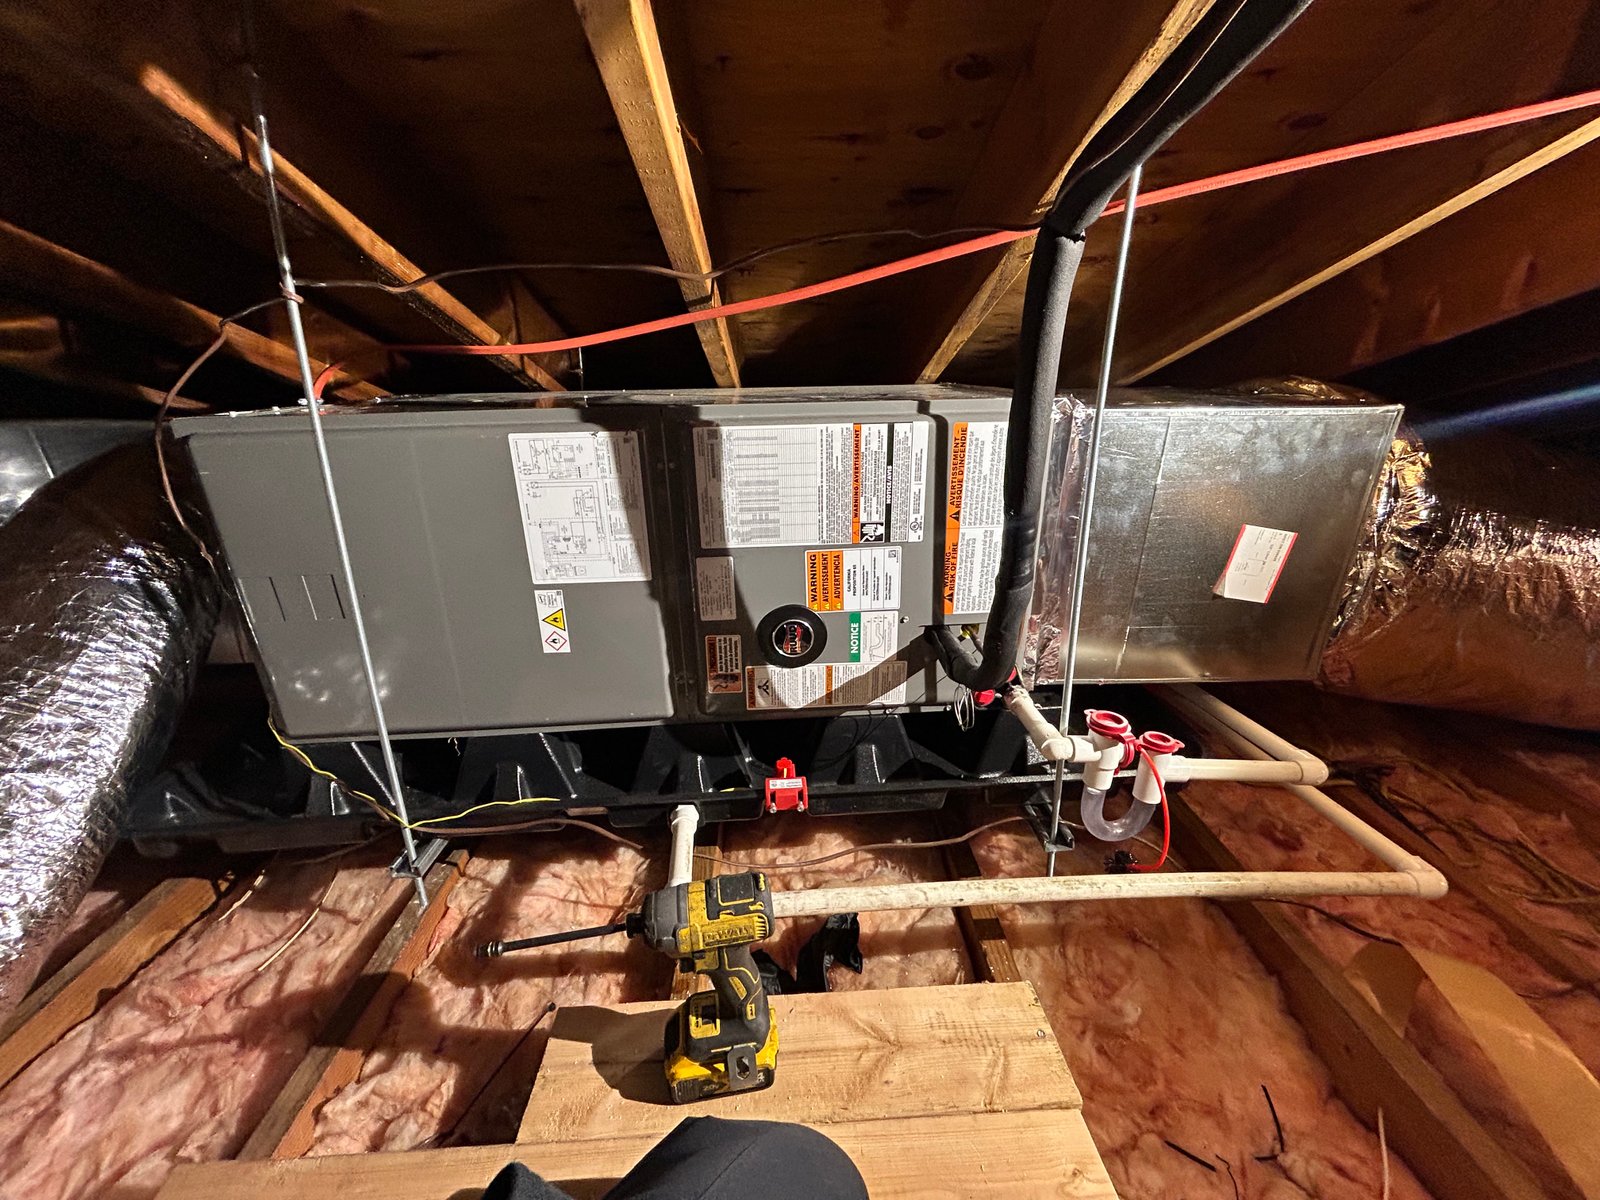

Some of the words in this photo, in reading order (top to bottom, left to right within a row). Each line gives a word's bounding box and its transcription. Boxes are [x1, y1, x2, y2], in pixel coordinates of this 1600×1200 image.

[958, 427, 967, 475] D'INCENDIE
[950, 437, 959, 506] AVERTISSEMENT
[789, 626, 797, 652] RUUD
[850, 623, 858, 654] NOTICE
